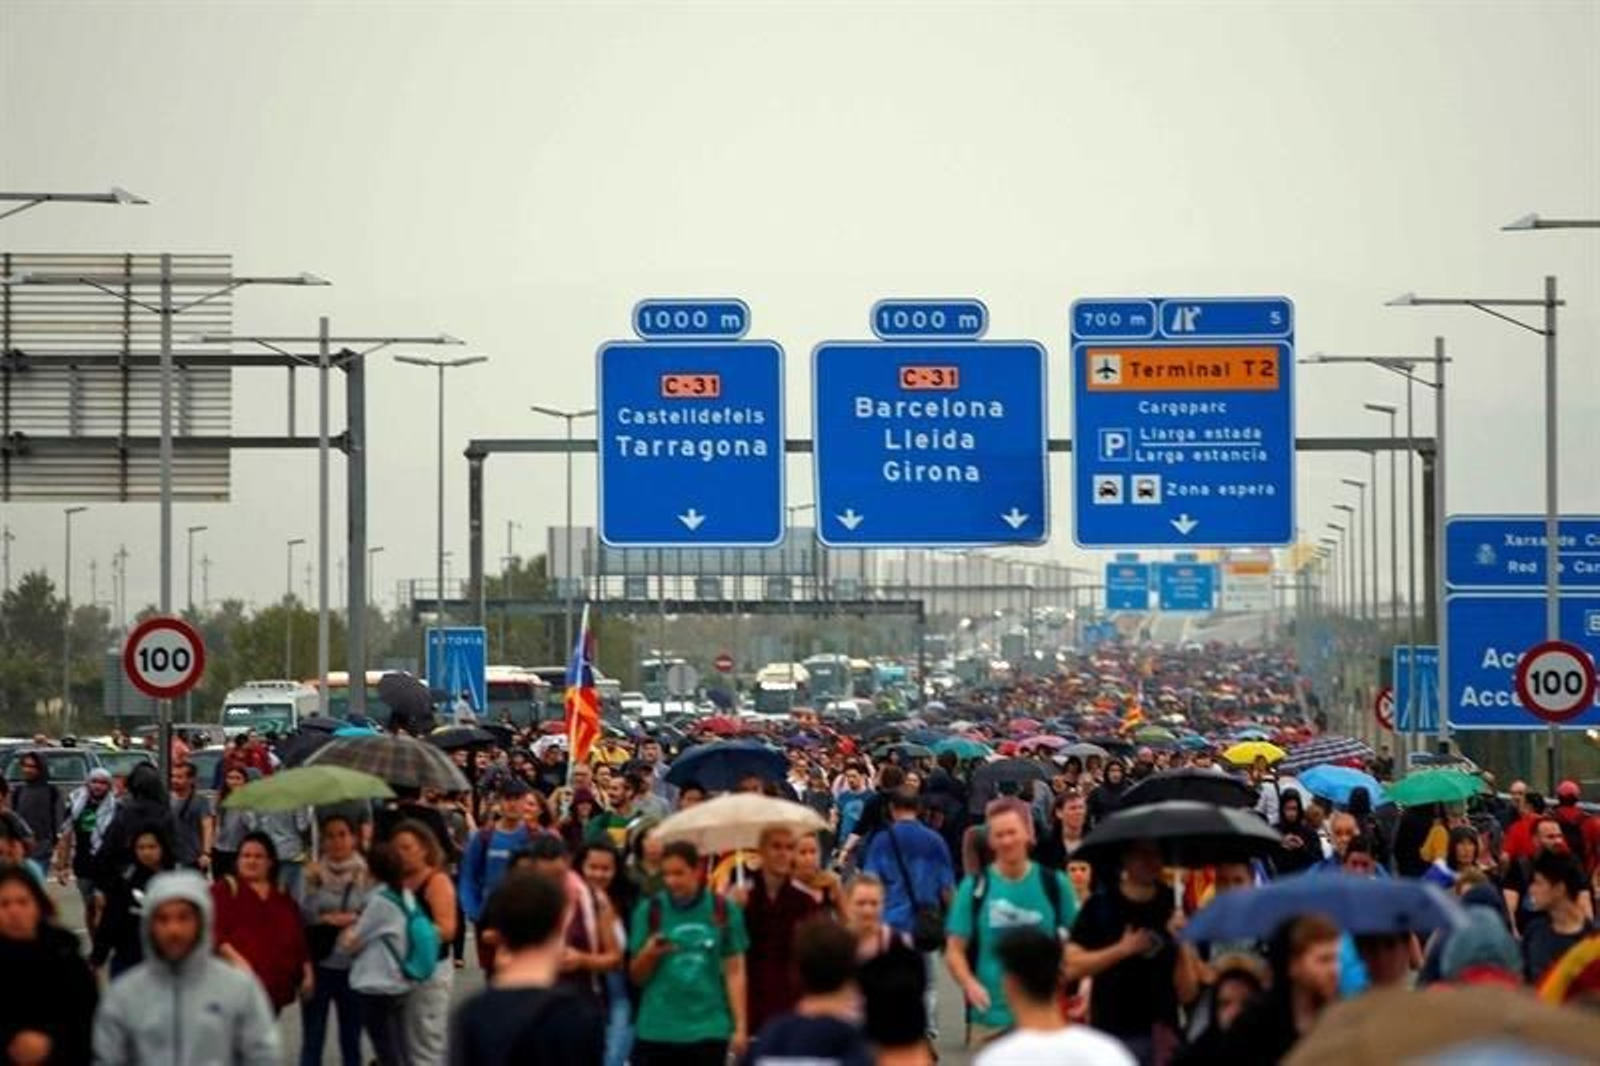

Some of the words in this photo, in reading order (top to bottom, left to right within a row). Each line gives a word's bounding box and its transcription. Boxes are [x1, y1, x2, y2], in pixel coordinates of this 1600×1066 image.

[642, 311, 708, 329] 1000
[720, 314, 741, 328] m
[880, 311, 946, 329] 1000
[958, 314, 979, 329] m
[1083, 312, 1122, 327] 700
[1130, 315, 1146, 326] m
[1269, 310, 1282, 325] 5
[902, 368, 956, 387] C-31
[1130, 361, 1231, 378] Terminal
[1243, 359, 1275, 377] T2
[664, 377, 718, 395] C-31
[618, 407, 765, 425] Castelldefels
[855, 396, 1004, 418] Barcelona
[1138, 400, 1227, 417] Cargoparc
[885, 428, 975, 450] Lleida
[1139, 427, 1196, 442] Llarga
[1204, 427, 1262, 440] estada
[615, 435, 768, 462] Tarragona
[1105, 432, 1126, 457] P
[1135, 449, 1185, 465] Larga
[1192, 449, 1268, 462] estancia
[883, 460, 980, 482] Girona
[1166, 482, 1210, 496] Zona
[1218, 484, 1276, 499] espera
[1508, 561, 1537, 574] Red
[138, 648, 191, 672] 100
[1530, 670, 1583, 696] 100
